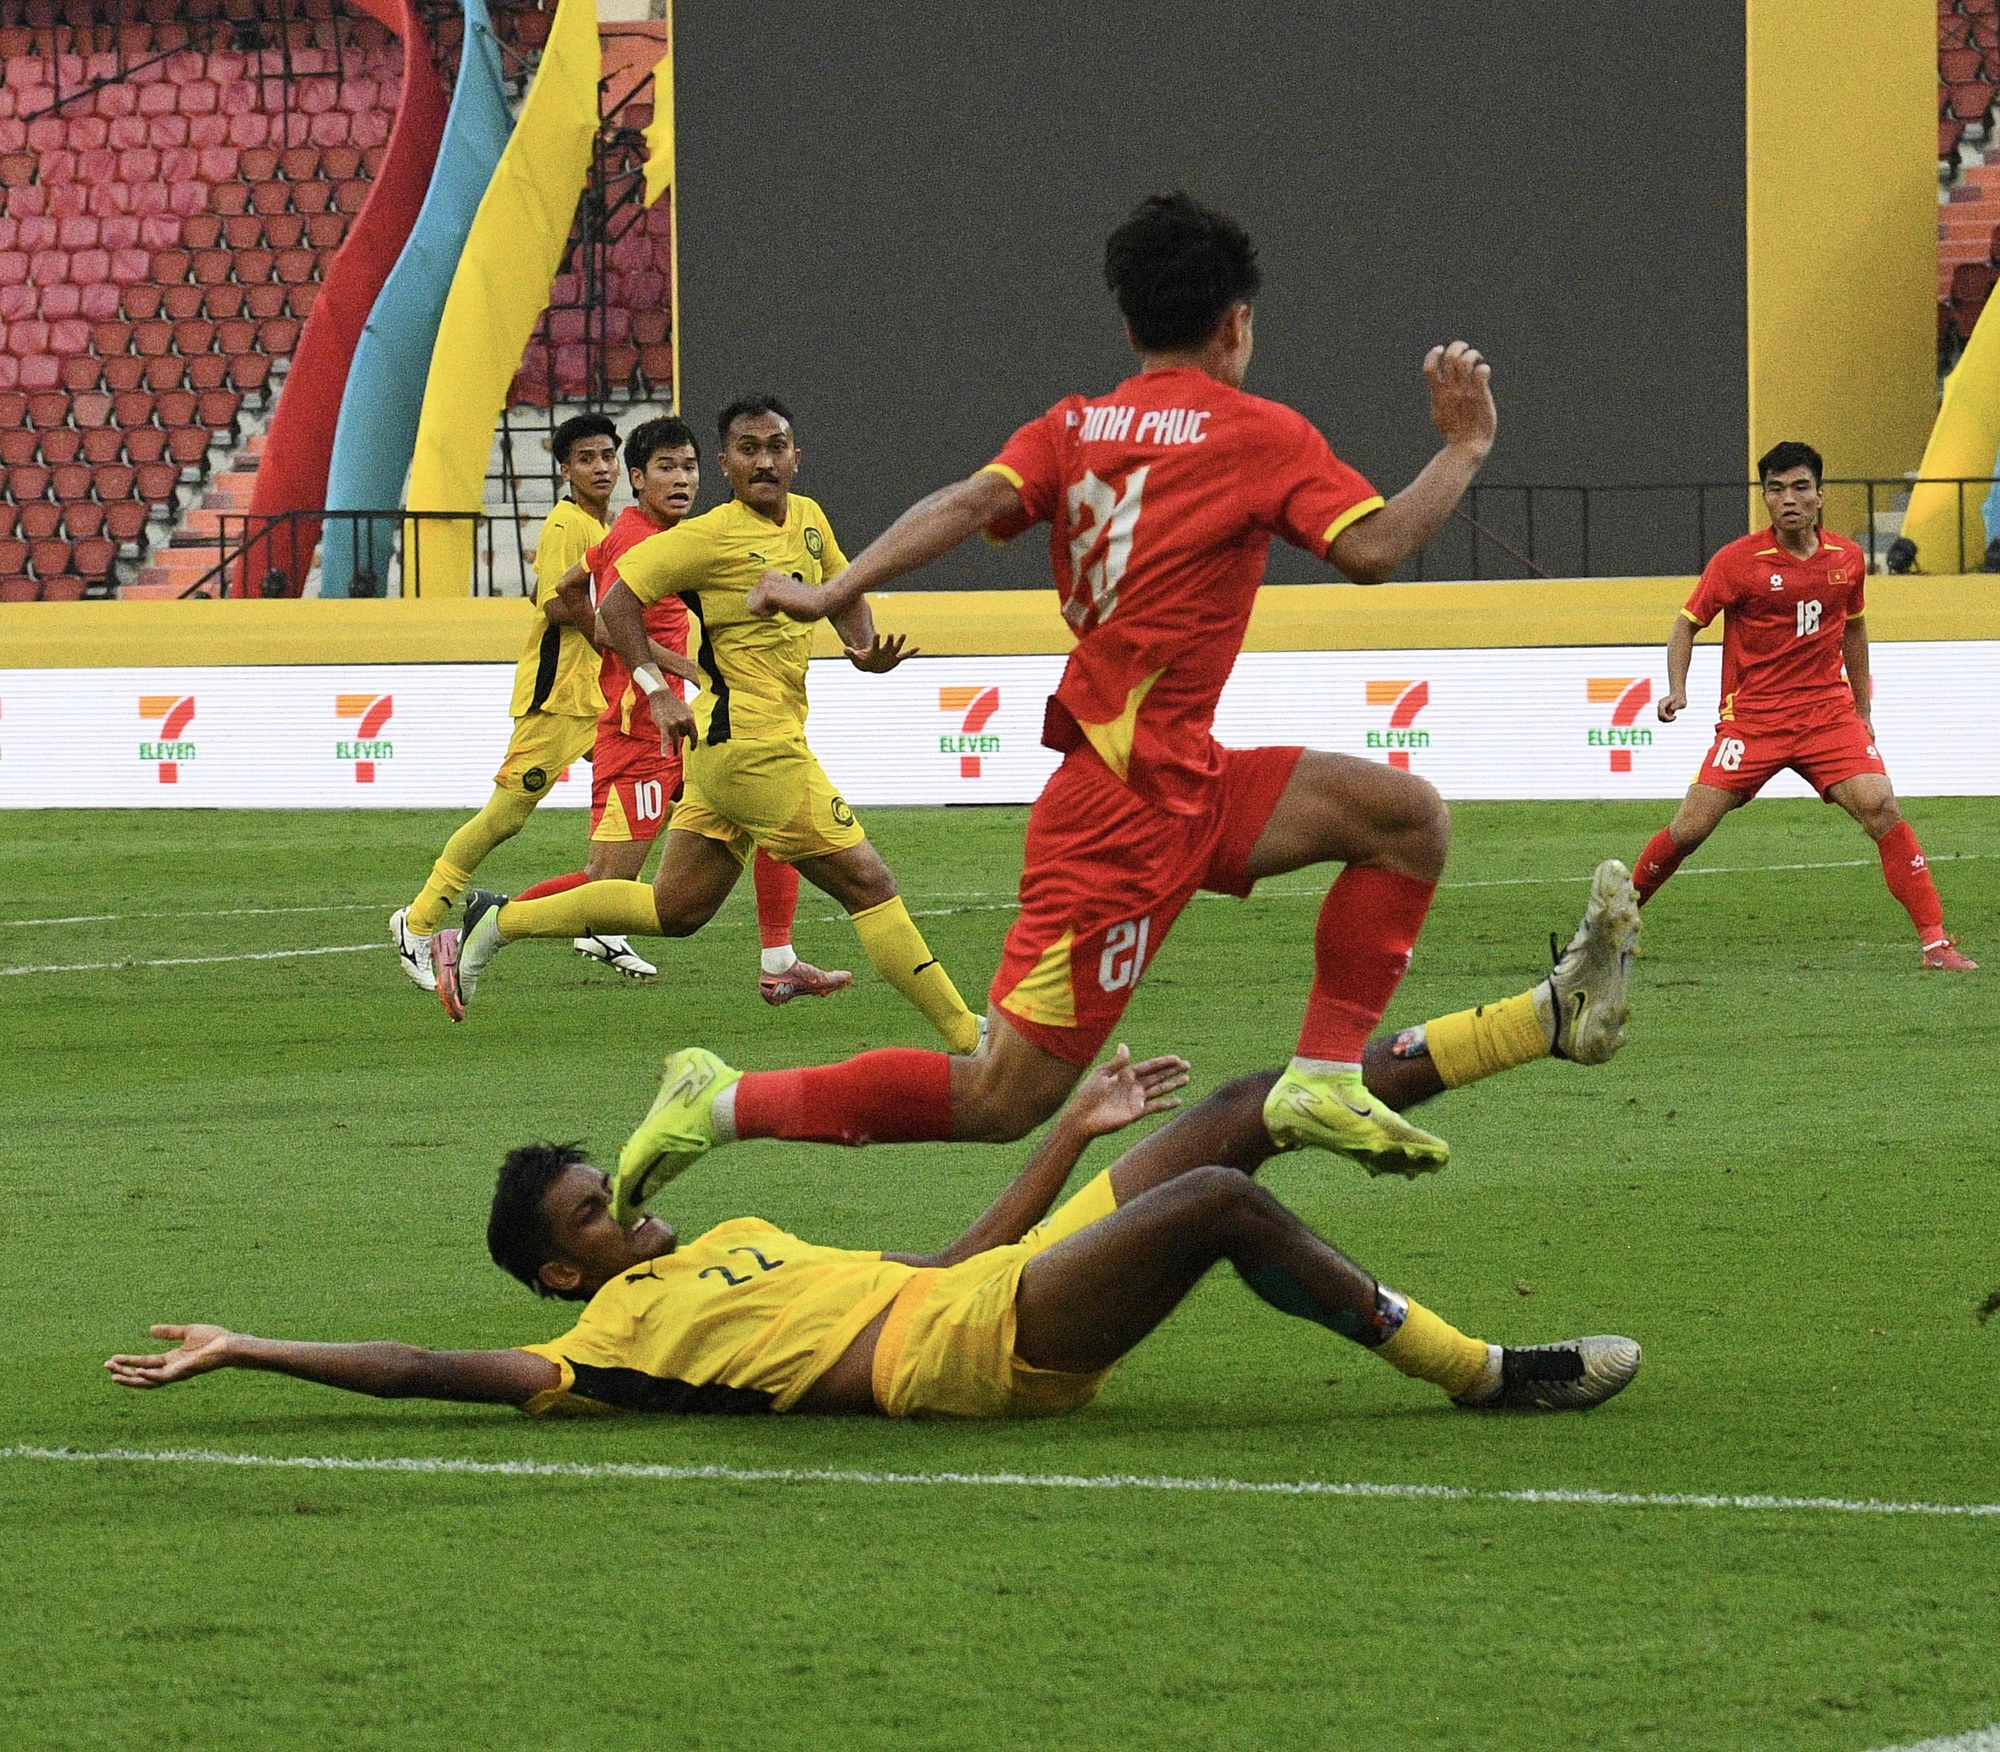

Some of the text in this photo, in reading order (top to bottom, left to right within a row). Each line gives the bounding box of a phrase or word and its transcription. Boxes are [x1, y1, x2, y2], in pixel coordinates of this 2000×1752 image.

[1135, 408, 1211, 445] PHUC
[1062, 464, 1150, 626] 21
[1796, 599, 1822, 637] 18
[139, 695, 195, 783] 7
[336, 694, 393, 783] 7
[939, 686, 999, 778] 7
[1366, 680, 1429, 772] 7
[1587, 678, 1651, 772] 7
[1712, 737, 1746, 771] 18
[634, 779, 663, 821] 10
[1099, 916, 1150, 993] 21
[698, 1246, 785, 1287] 22
